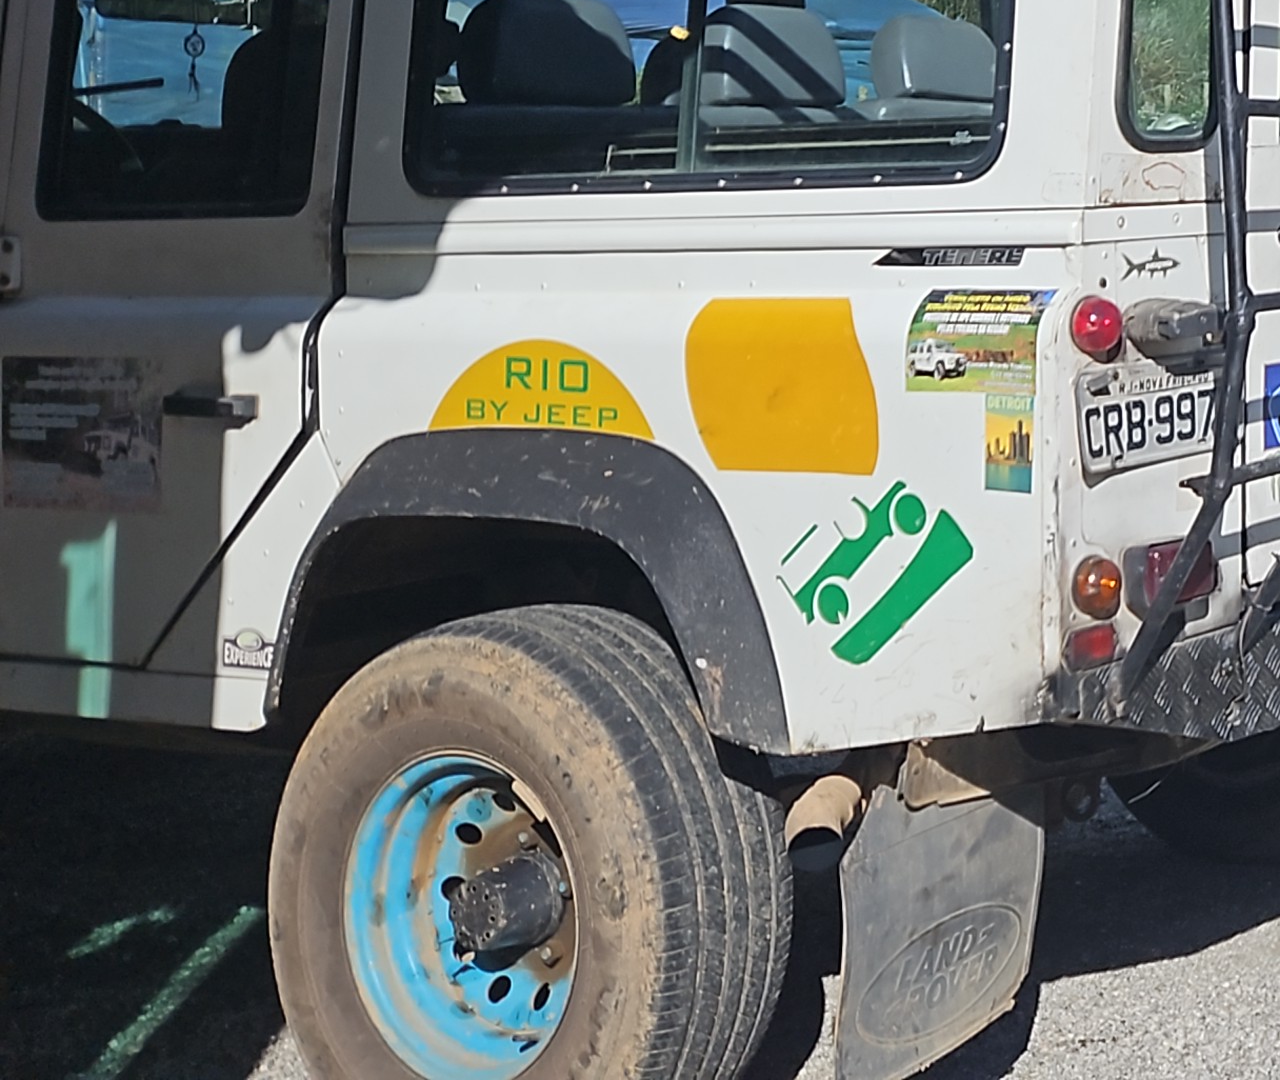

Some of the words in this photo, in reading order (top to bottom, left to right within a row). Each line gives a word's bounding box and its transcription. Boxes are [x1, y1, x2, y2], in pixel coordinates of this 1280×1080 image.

[505, 356, 590, 393] RIO
[466, 399, 509, 421] BY
[524, 403, 618, 428] JEEP
[987, 394, 1031, 411] DETROIT
[893, 923, 979, 995] LAND
